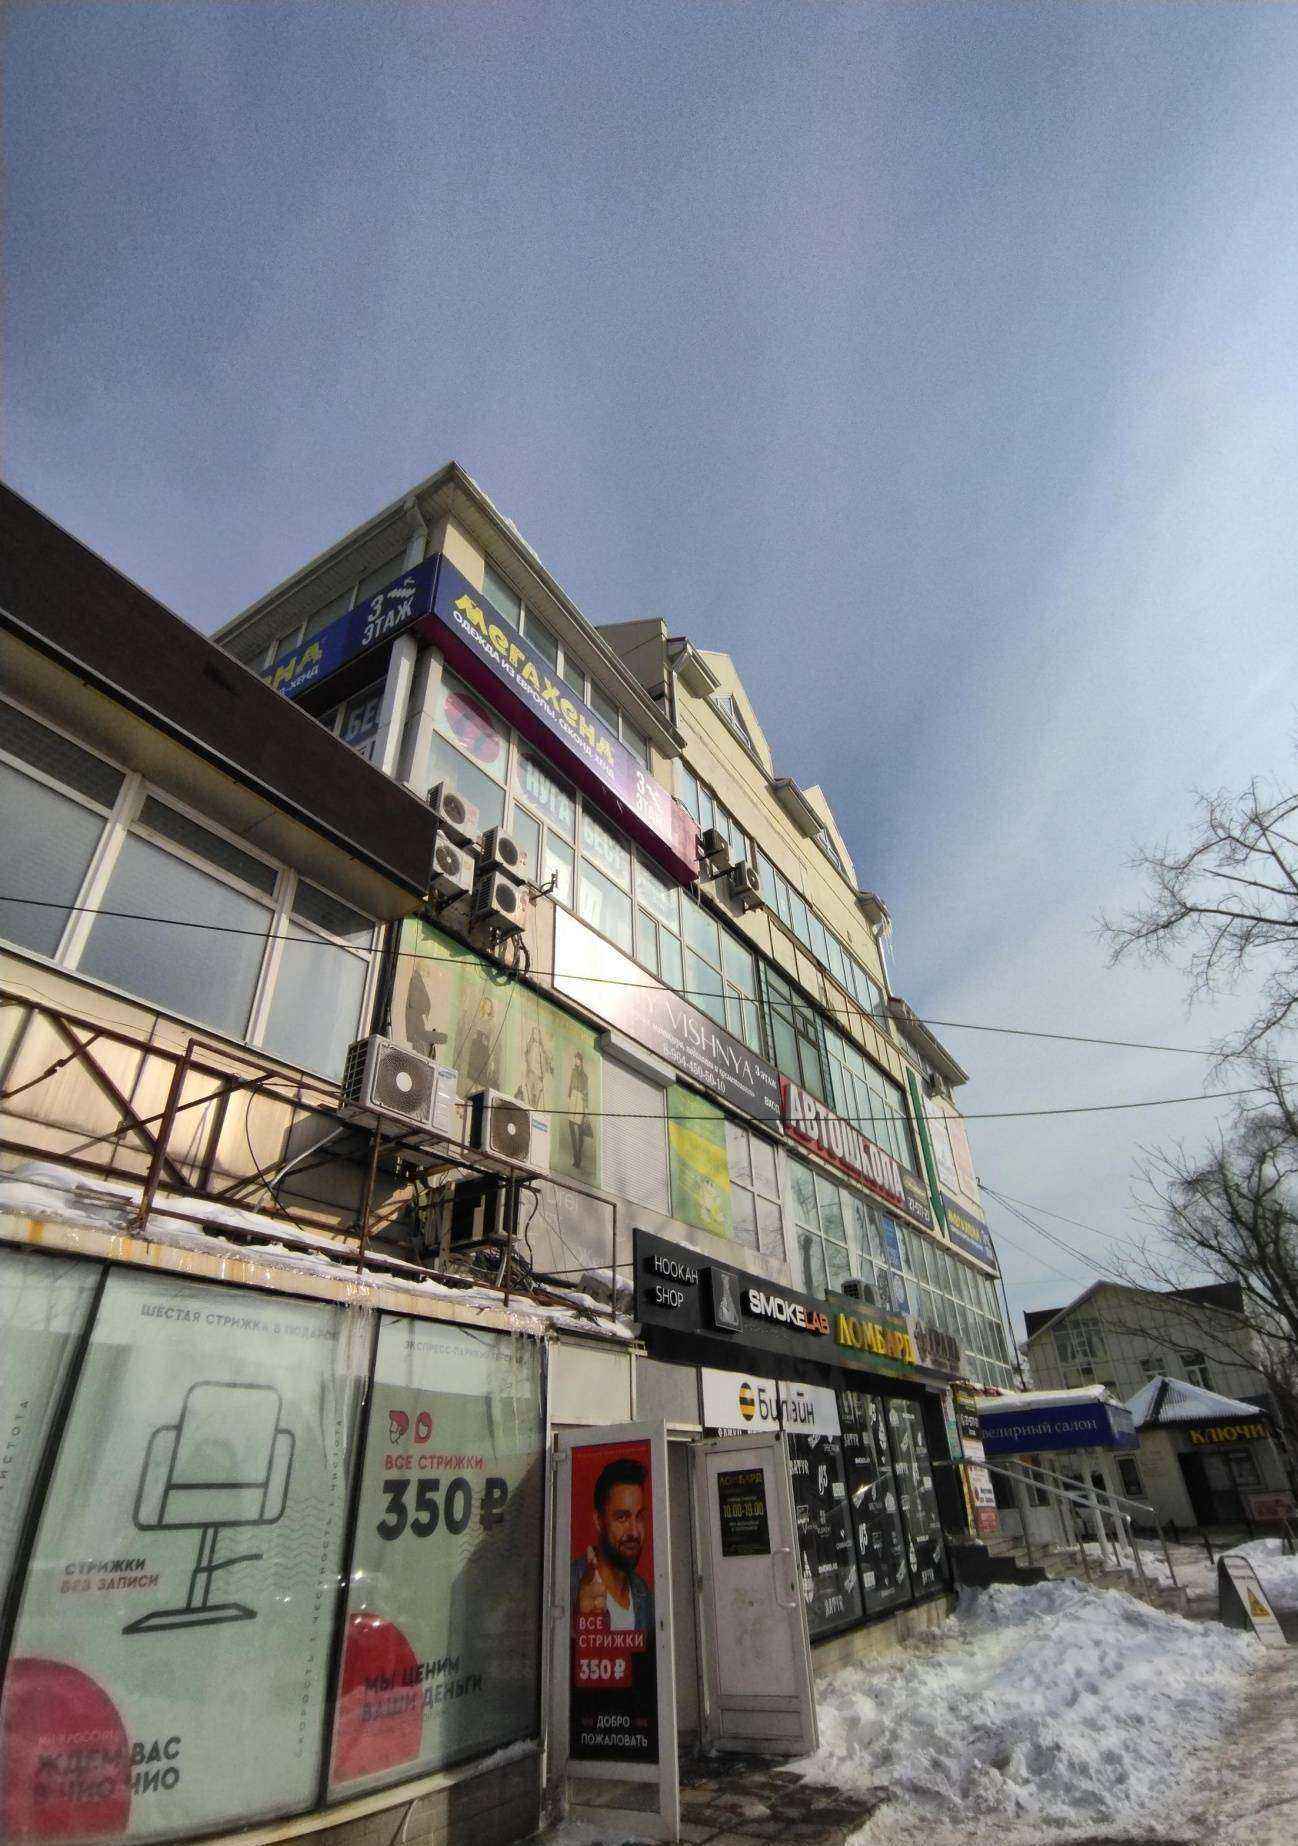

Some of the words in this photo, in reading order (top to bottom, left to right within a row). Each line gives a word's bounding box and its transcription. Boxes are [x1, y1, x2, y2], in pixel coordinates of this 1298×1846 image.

[362, 596, 414, 646] ЭТАЖ
[453, 610, 500, 664] ОДЕЖДА
[501, 660, 515, 677] ИЗ
[666, 1000, 755, 1085] VISHNYA
[789, 1083, 905, 1200] АВТОШКОЛА
[654, 1254, 699, 1285] HOOKAH
[656, 1285, 684, 1307] SHOP
[141, 1304, 200, 1322] ШЕСТАЯ
[748, 1288, 830, 1336] SMOKELAB
[982, 1420, 1051, 1441] велирный
[1054, 1419, 1098, 1434] салон
[1189, 1423, 1266, 1445] КЛЮЧИ
[384, 1454, 413, 1470] ВСЕ
[418, 1454, 484, 1470] СТРИЖКИ
[65, 1558, 146, 1575] СТРИЖКИ
[97, 1575, 159, 1591] ЗАПИСИ
[579, 1616, 604, 1630] ВСЕ
[579, 1633, 645, 1648] СТРИЖКИ
[401, 1655, 461, 1687] ЦЕНИМ
[424, 1673, 482, 1709] ДЕНЬГИ
[597, 1715, 631, 1729] ДОБРО
[581, 1732, 648, 1747] ПОЖАЛОВАТЬ
[129, 1736, 182, 1767] ВАС
